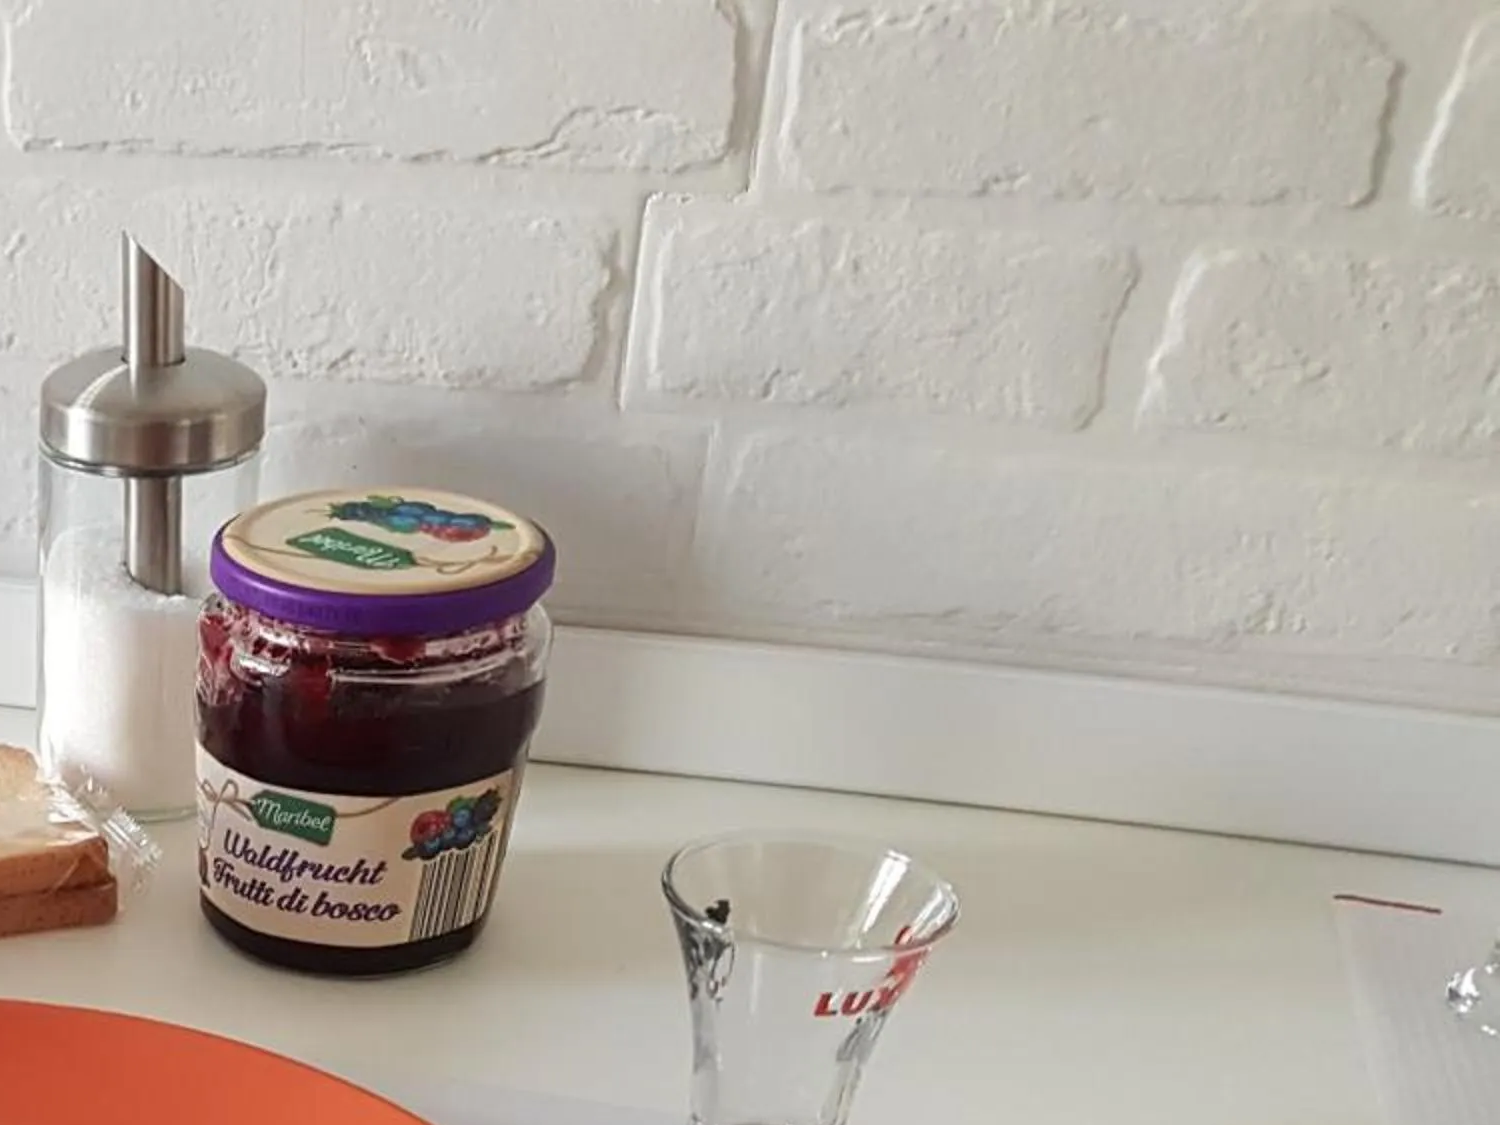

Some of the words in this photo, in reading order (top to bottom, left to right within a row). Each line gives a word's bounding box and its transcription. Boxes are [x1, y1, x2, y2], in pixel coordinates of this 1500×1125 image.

[257, 799, 331, 833] Maribel
[223, 828, 388, 886] Waldfrucht
[213, 857, 276, 908] Frutti
[276, 887, 310, 914] di
[311, 891, 402, 922] bosco
